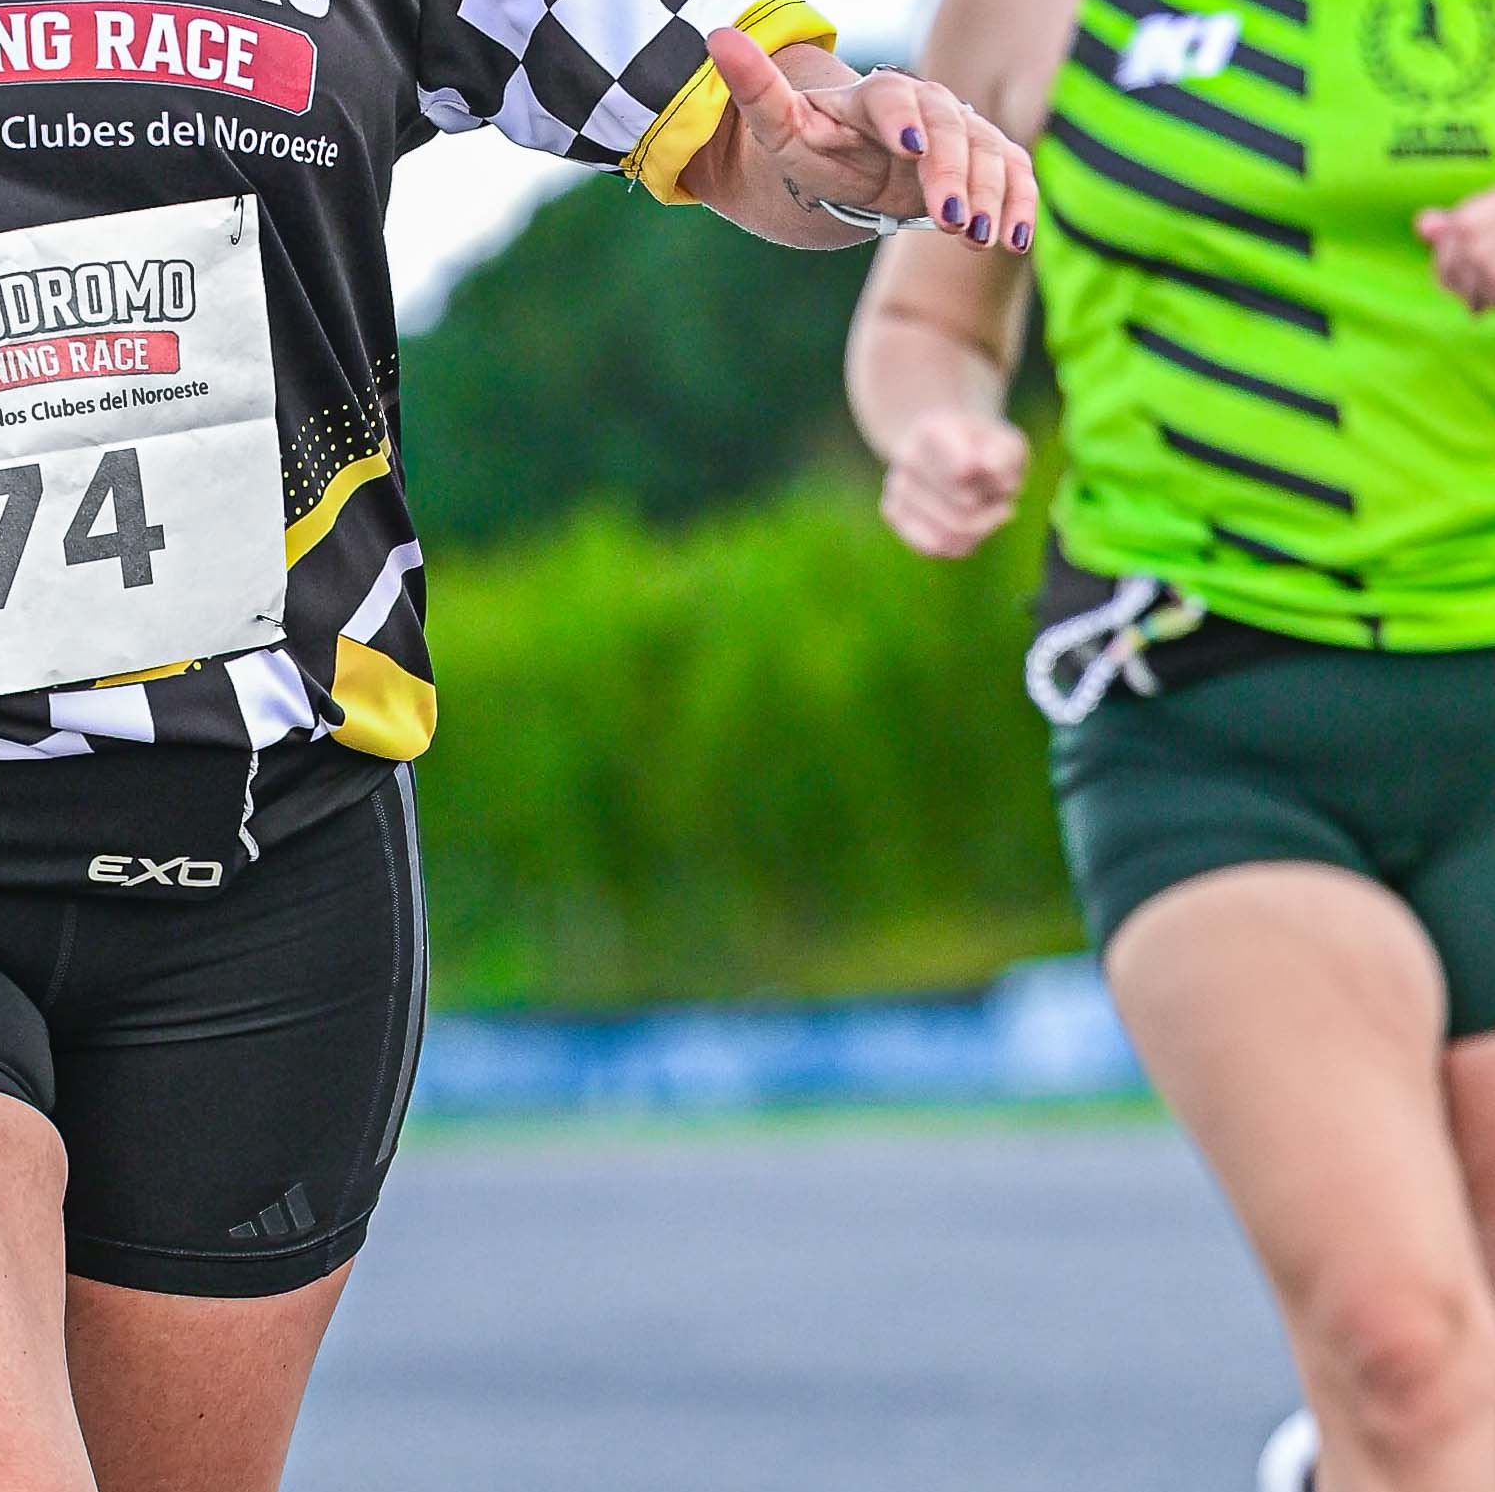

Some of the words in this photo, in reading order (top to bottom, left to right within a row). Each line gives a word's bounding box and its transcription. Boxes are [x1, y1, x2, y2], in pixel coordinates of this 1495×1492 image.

[95, 9, 259, 91] RACE
[1, 111, 136, 150] Clubes
[146, 111, 205, 147] del
[214, 115, 339, 168] Noroeste
[68, 338, 150, 373] RACE
[31, 398, 96, 421] Clubes
[99, 389, 128, 411] del
[131, 380, 210, 407] Noroeste
[88, 855, 224, 887] EXO
